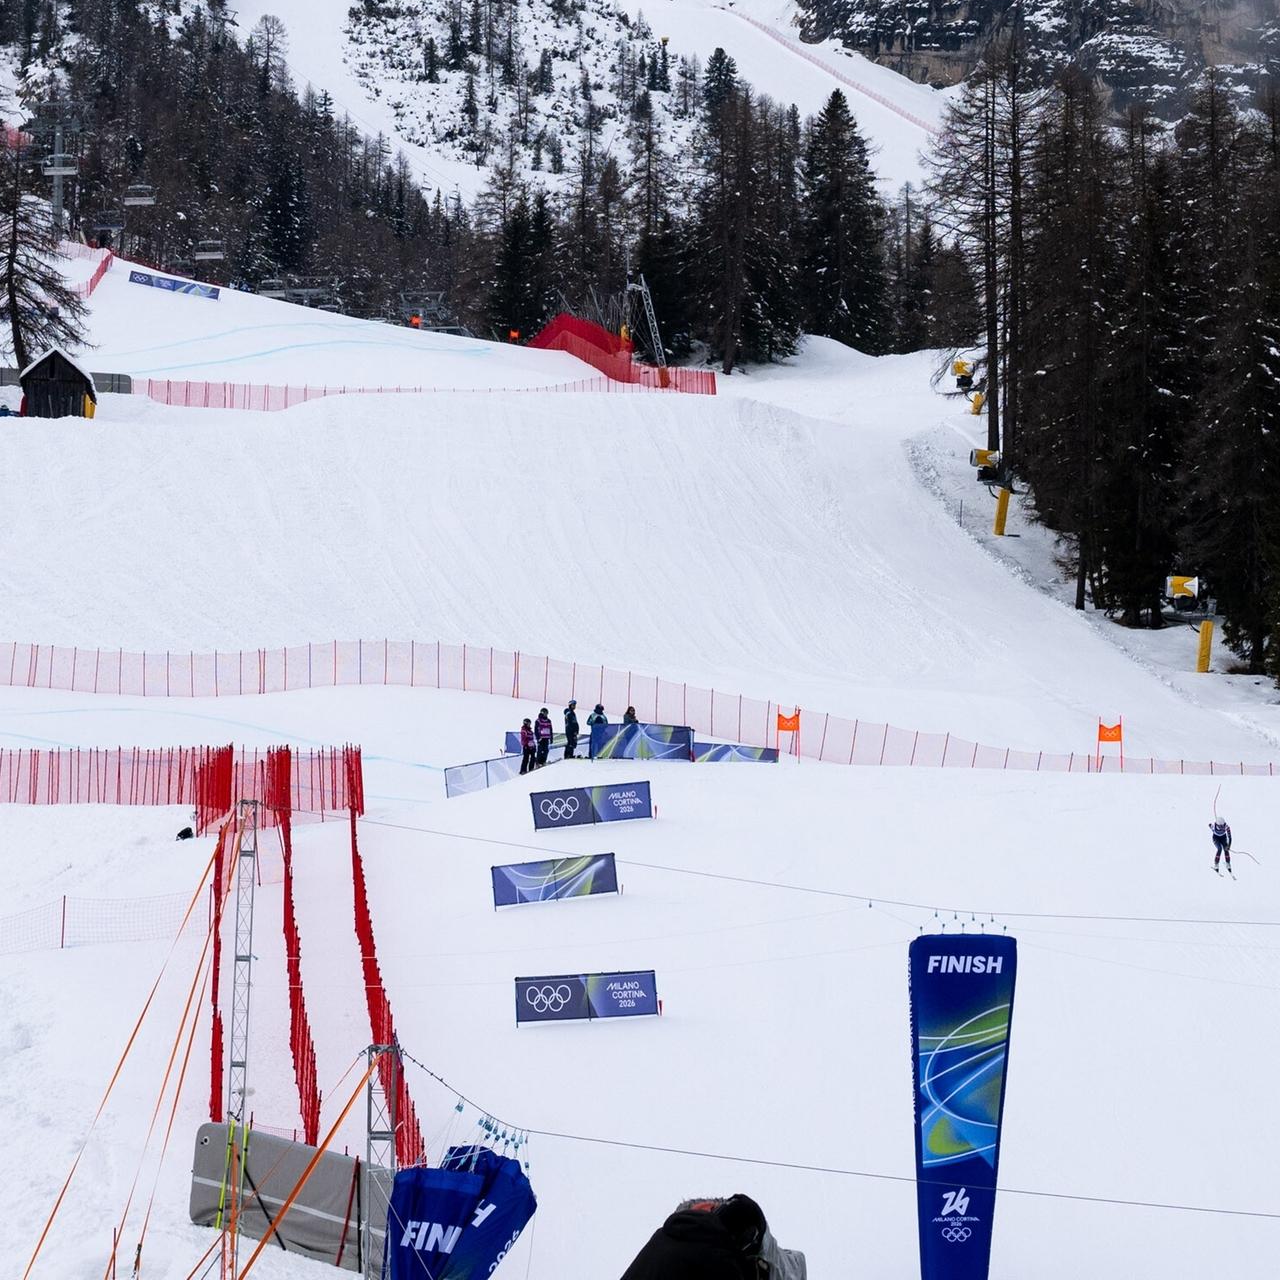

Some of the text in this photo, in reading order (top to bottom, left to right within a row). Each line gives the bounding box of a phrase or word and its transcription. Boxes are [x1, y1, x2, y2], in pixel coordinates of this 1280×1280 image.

[608, 790, 637, 800] MILANO
[612, 798, 643, 807] CORTINA
[619, 805, 635, 814] 2026
[927, 955, 1003, 974] FINISH
[606, 981, 640, 991] MILANO
[611, 990, 647, 1000] CORTINA
[618, 999, 636, 1008] 2026
